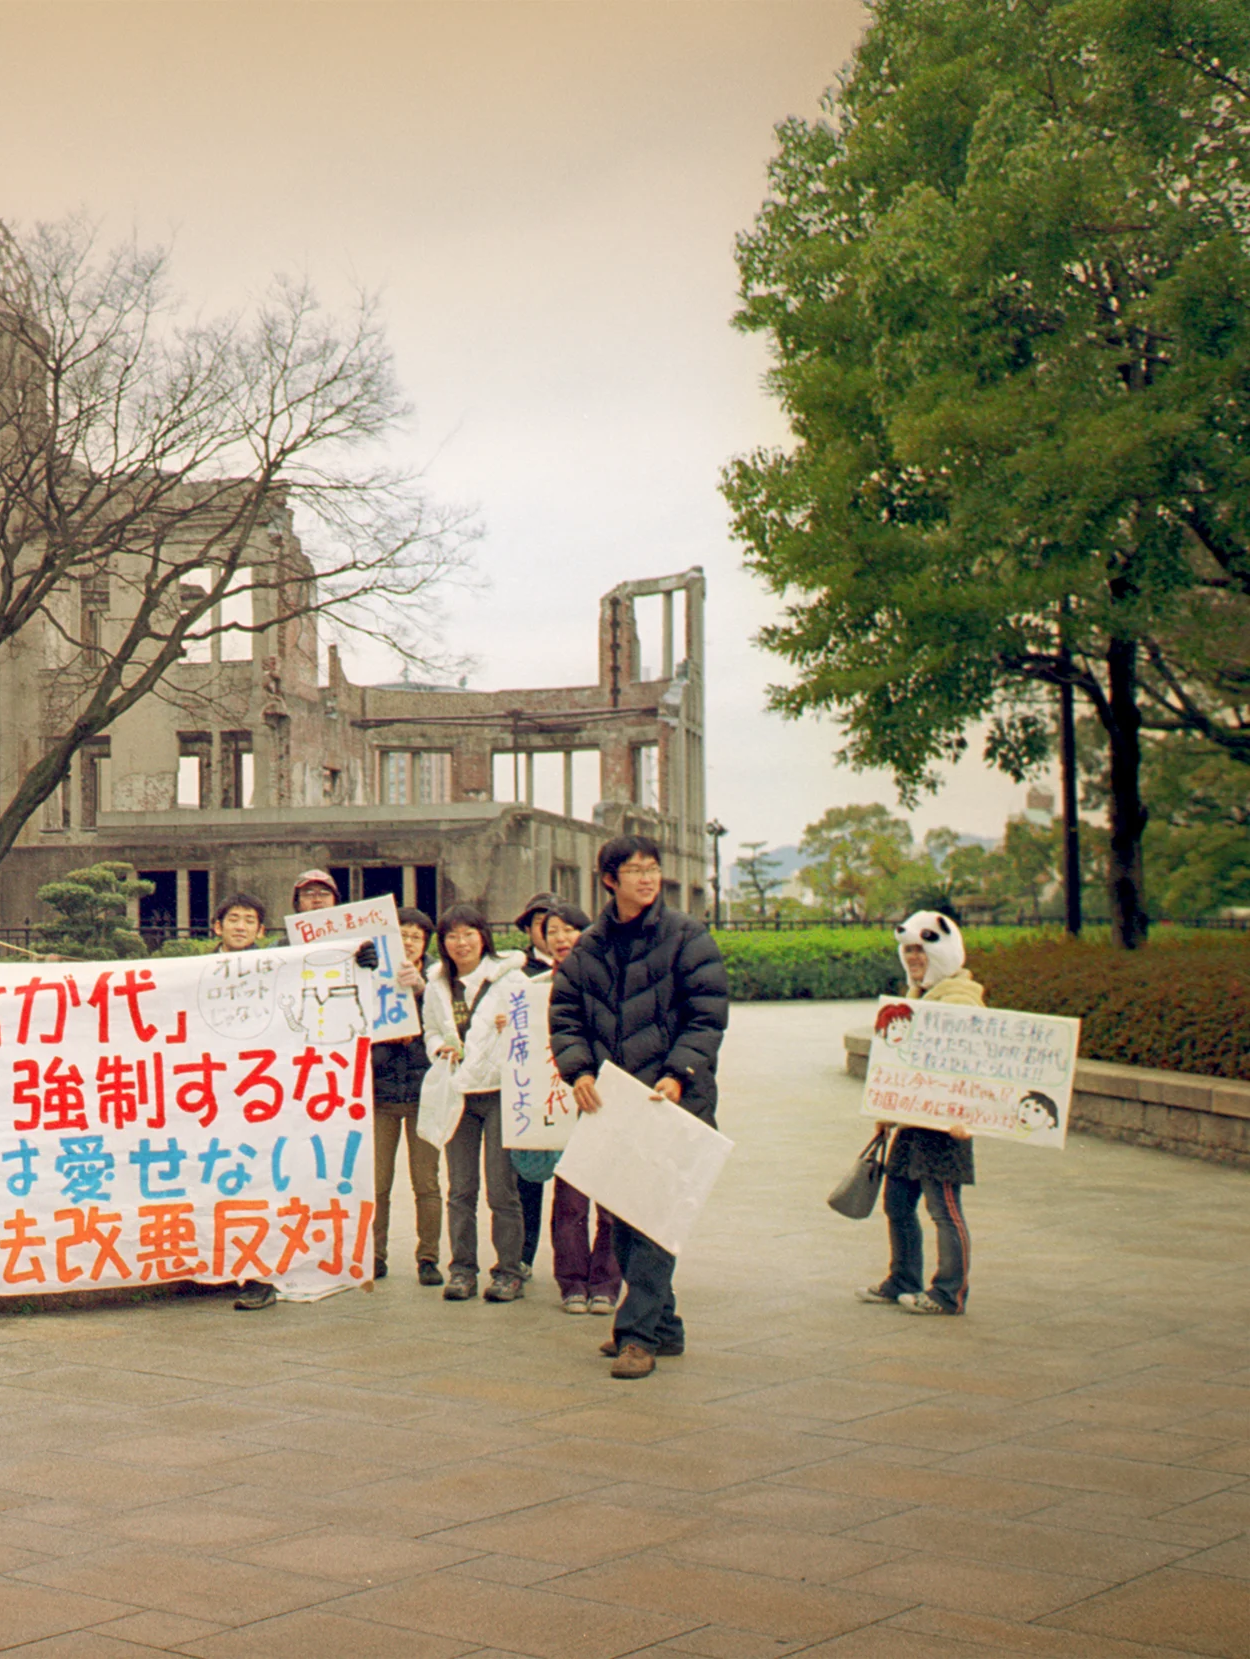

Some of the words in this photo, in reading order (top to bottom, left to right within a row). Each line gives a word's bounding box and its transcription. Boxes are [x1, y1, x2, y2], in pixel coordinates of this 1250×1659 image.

[212, 956, 274, 979] オレは
[206, 979, 269, 1001] ロボット
[210, 1006, 269, 1027] じゃない
[507, 990, 531, 1136] 着席しよう
[13, 1037, 372, 1131] 強制するな!
